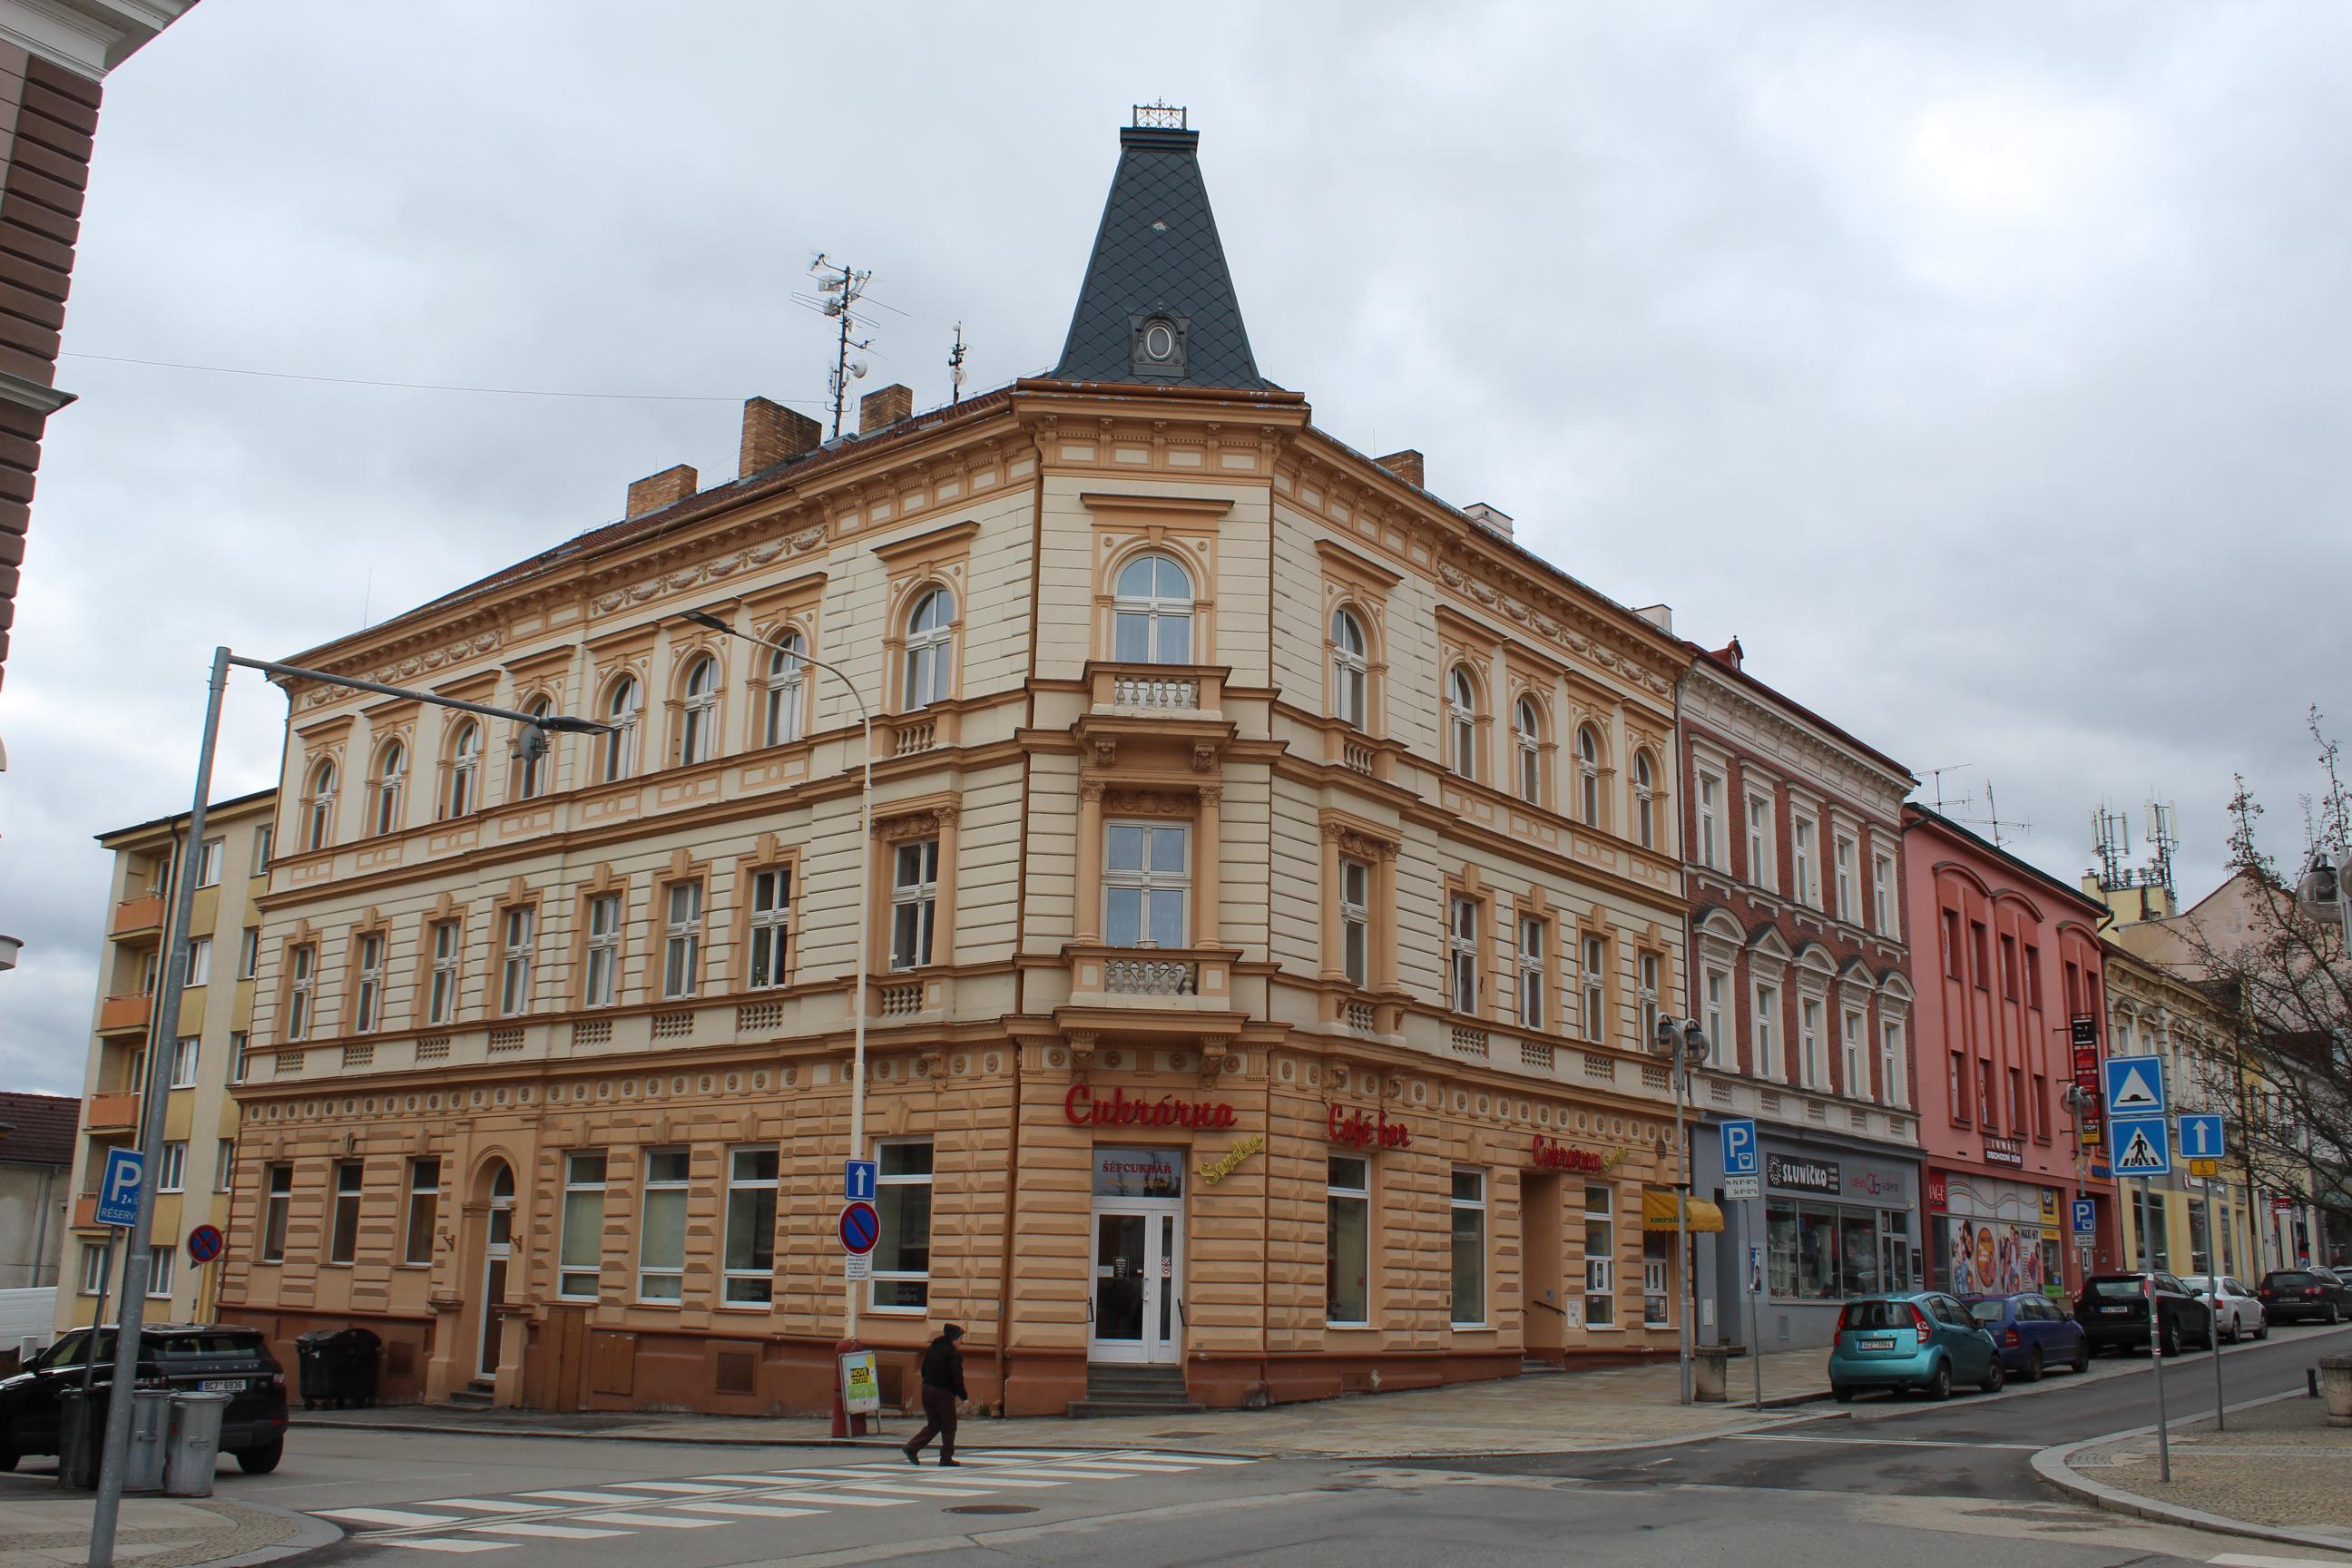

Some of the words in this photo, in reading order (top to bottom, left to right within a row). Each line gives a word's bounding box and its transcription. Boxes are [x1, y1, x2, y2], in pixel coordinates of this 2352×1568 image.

[1065, 1083, 1238, 1129] Cukrárna
[1378, 1111, 1412, 1148] bar
[1728, 1128, 1748, 1157] P
[1198, 1134, 1263, 1185] Sandra
[1533, 1133, 1602, 1172] Cukrárna
[111, 1160, 142, 1201] P
[1782, 1162, 1827, 1187] SLUNÍČKO
[2075, 1204, 2090, 1223] P
[204, 1380, 218, 1390] 8C7
